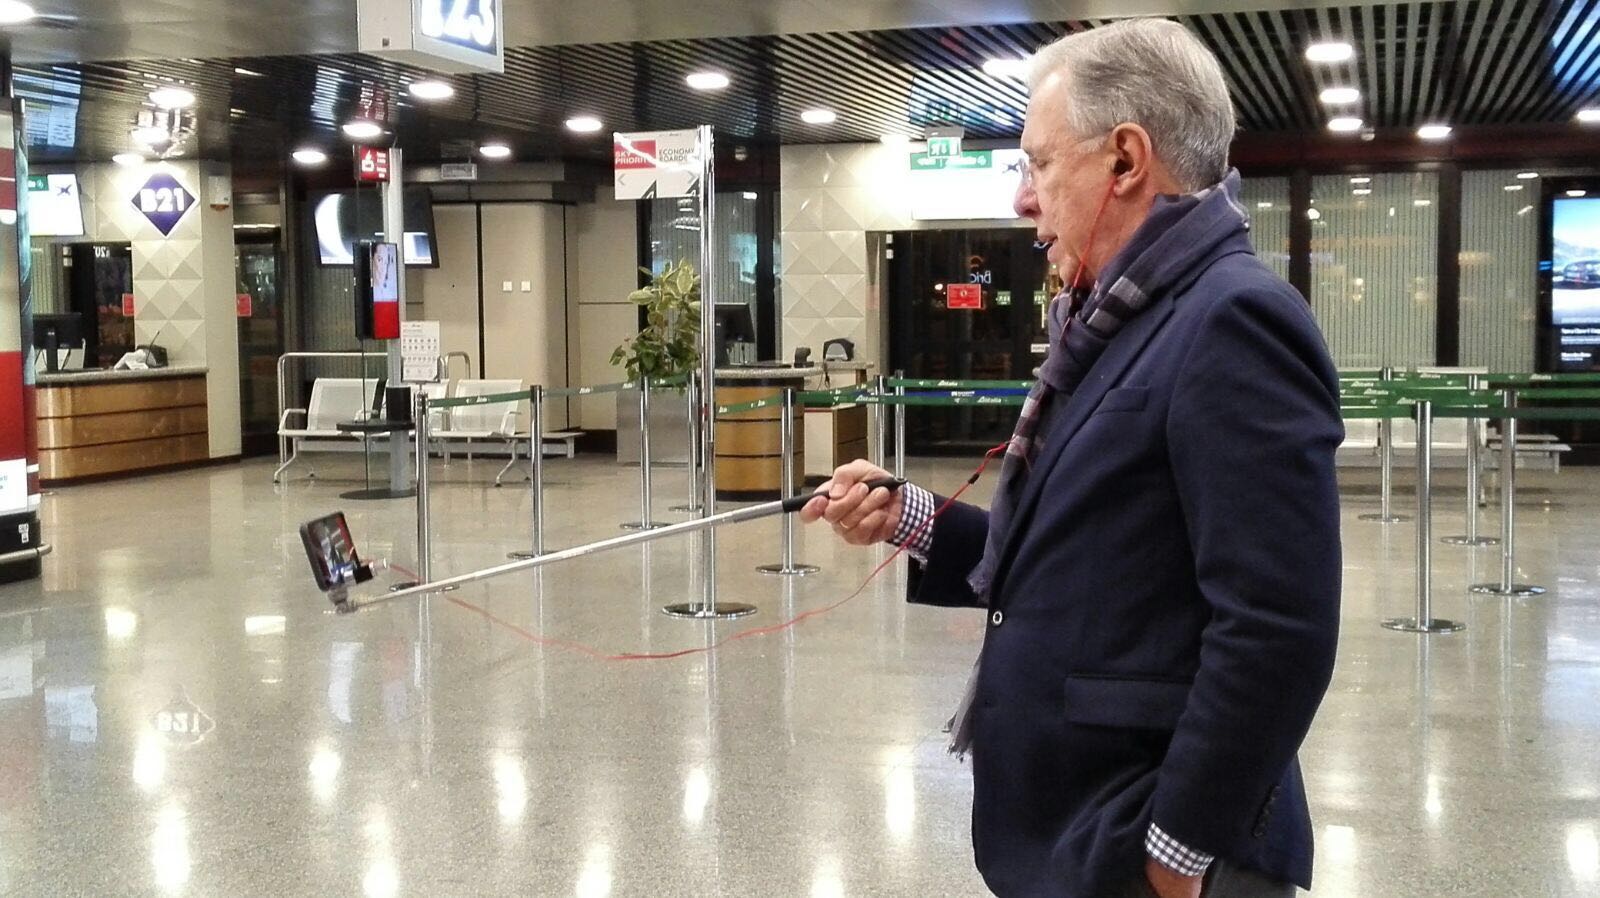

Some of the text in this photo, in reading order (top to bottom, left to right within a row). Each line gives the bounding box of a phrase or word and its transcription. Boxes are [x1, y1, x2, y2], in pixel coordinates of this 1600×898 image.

[614, 150, 631, 158] SKY
[659, 147, 695, 155] ECONOMY
[615, 156, 648, 164] PRIORIT
[140, 187, 185, 213] B21
